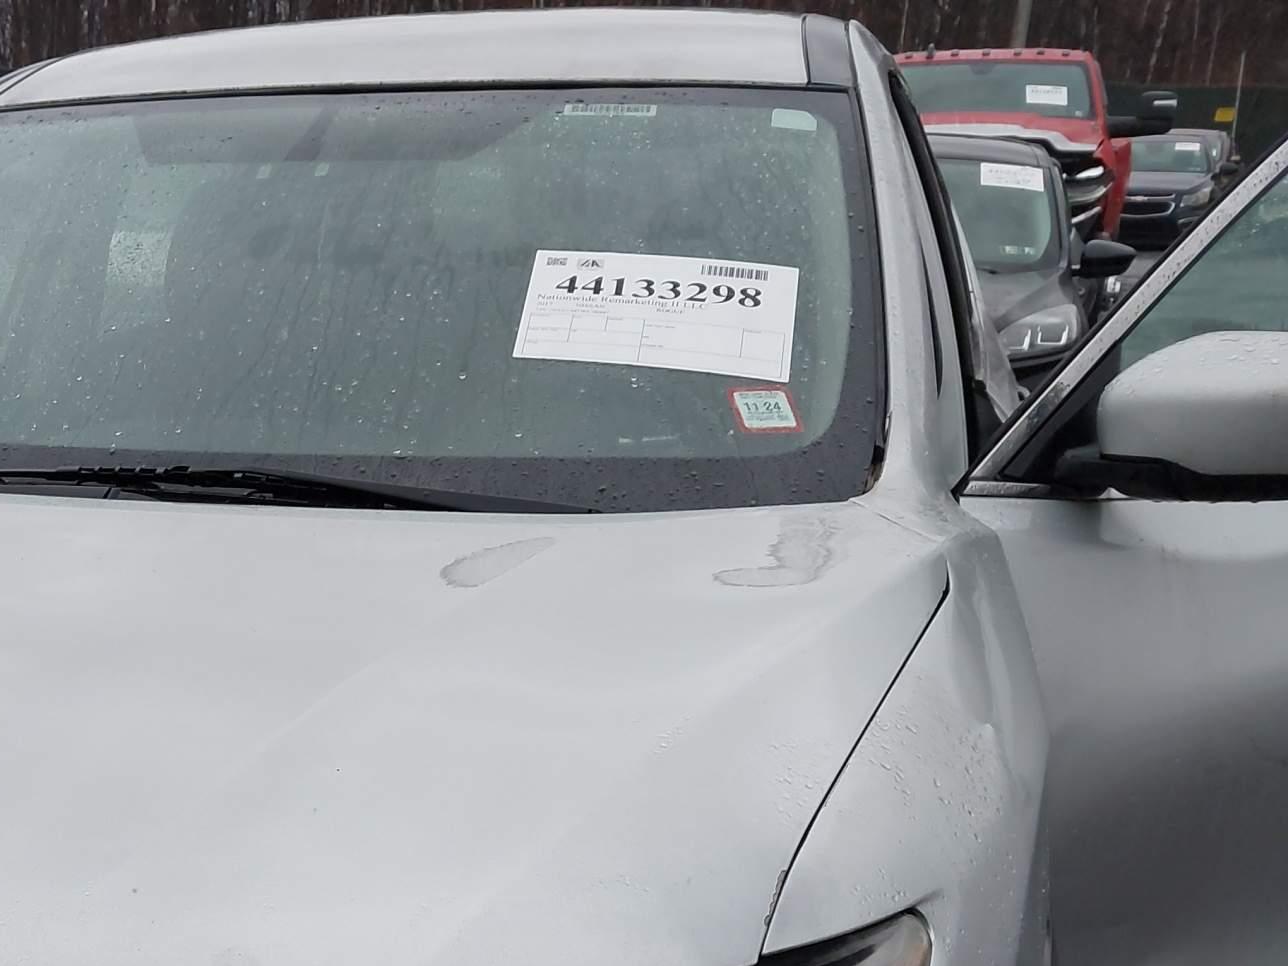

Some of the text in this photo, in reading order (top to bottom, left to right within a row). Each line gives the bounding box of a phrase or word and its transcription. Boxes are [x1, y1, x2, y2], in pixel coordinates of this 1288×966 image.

[537, 294, 599, 302] Nationwide
[601, 296, 668, 308] Remarketing
[555, 275, 763, 309] 44133298
